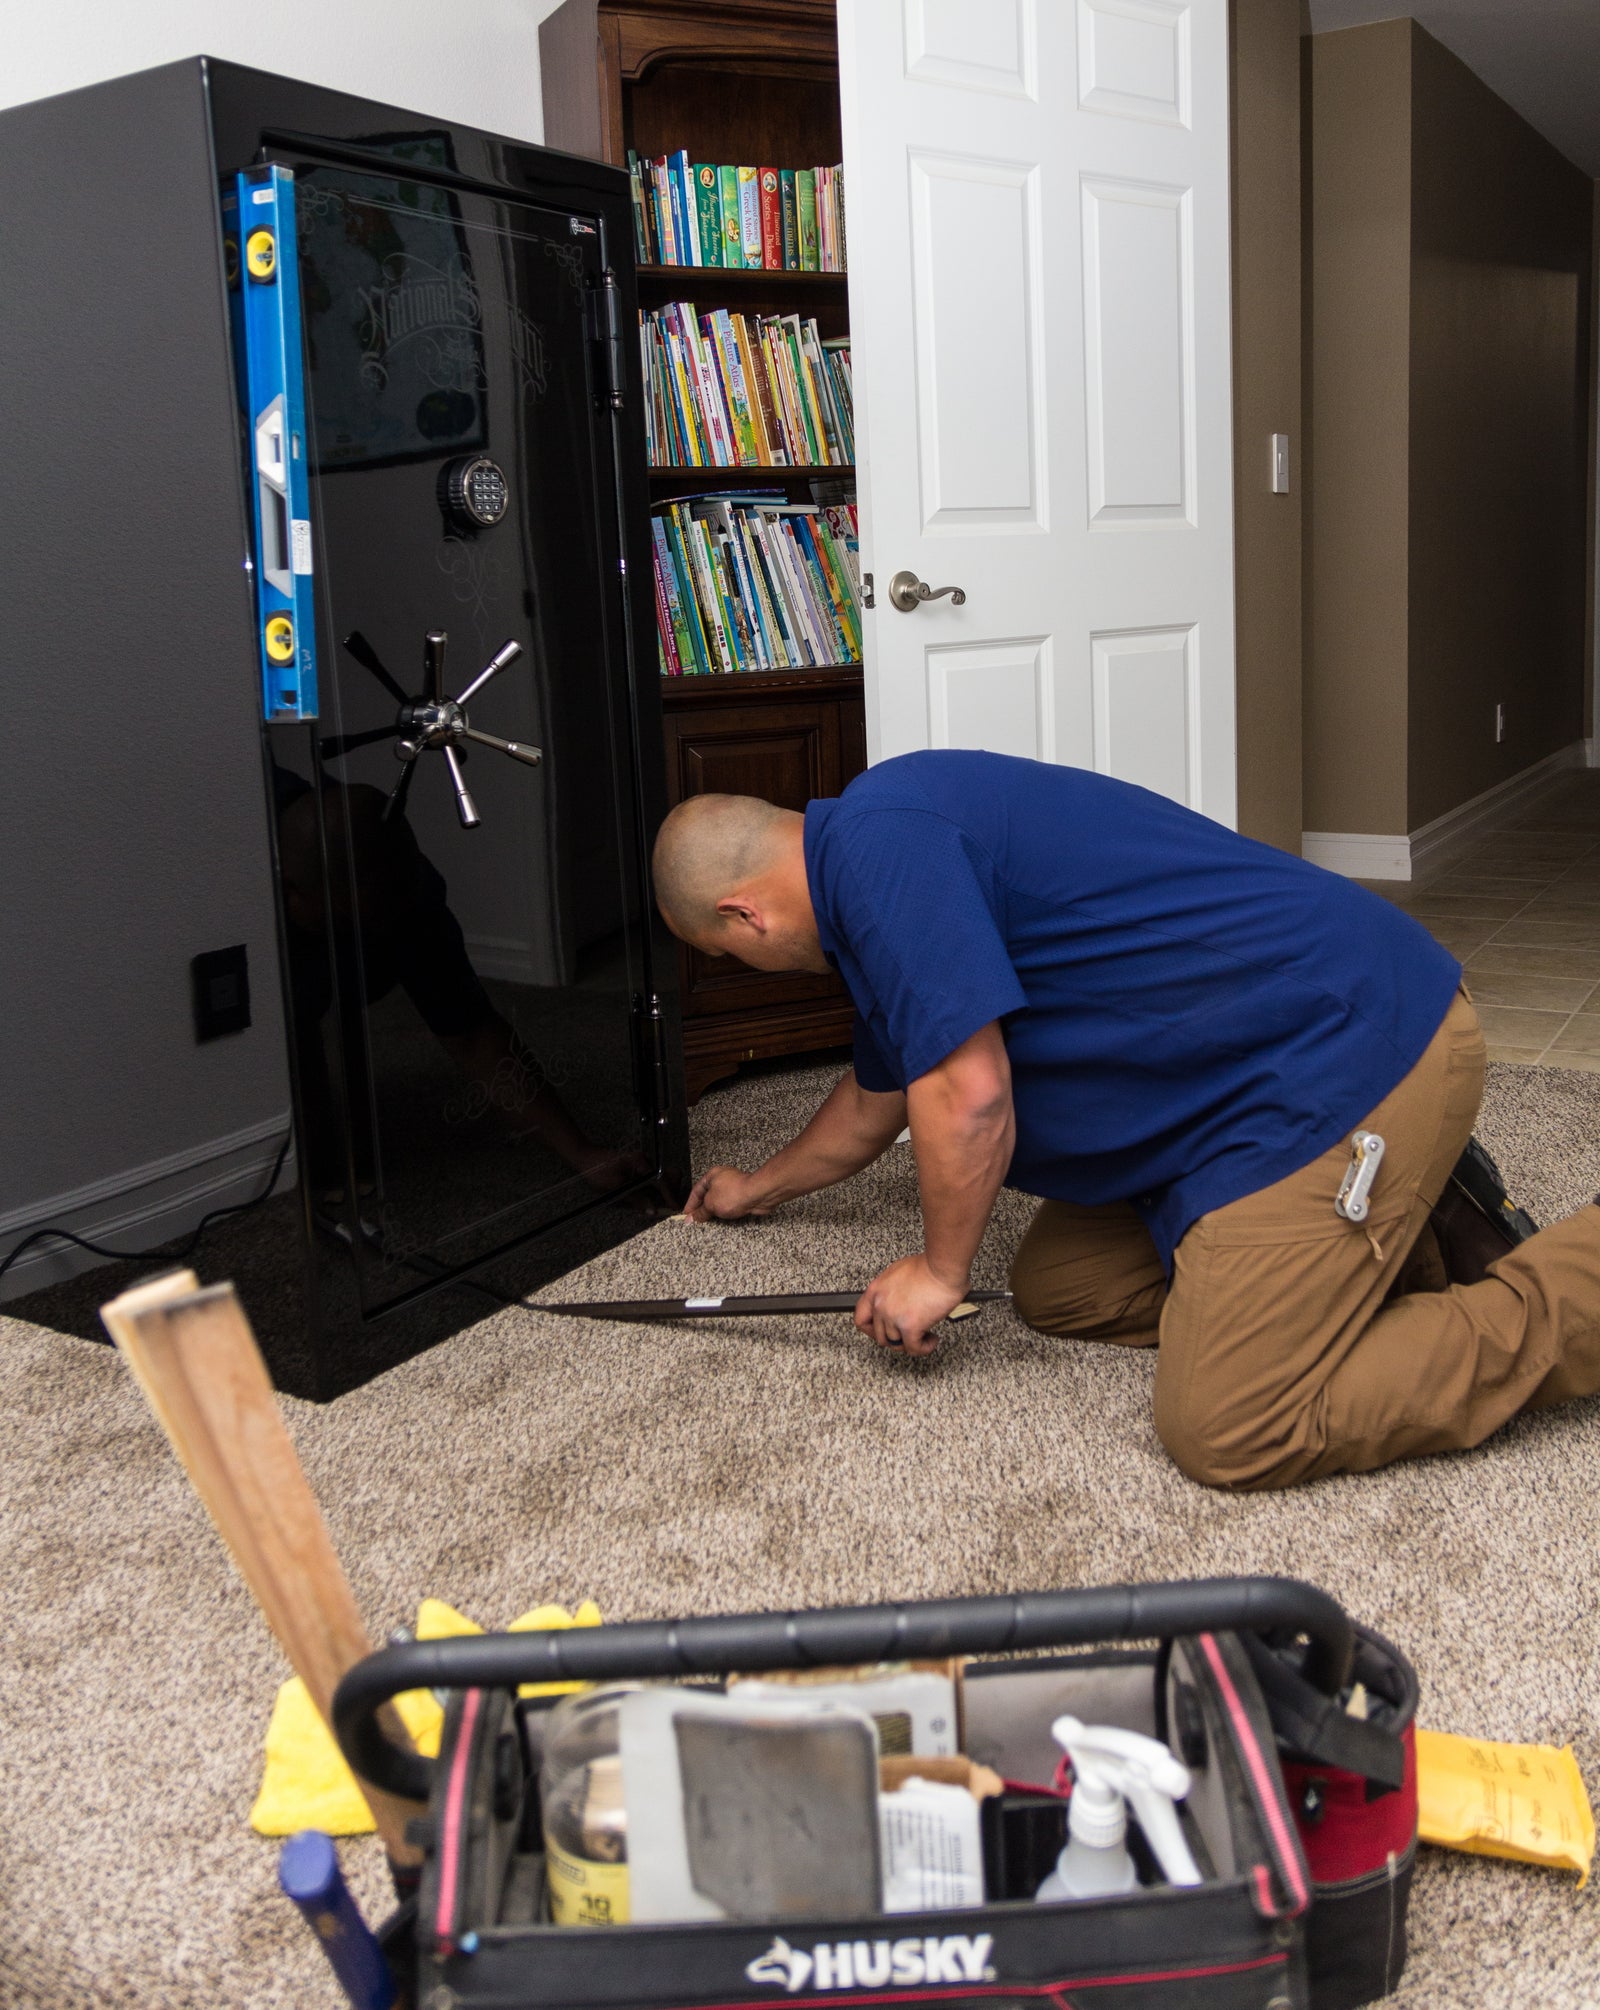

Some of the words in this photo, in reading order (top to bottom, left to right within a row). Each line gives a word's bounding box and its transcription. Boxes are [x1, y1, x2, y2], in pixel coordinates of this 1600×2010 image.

[743, 191, 751, 216] Greek
[764, 195, 773, 221] Stories
[744, 217, 753, 242] Myths
[773, 211, 782, 246] Illustrated
[723, 330, 736, 362] Picture
[730, 363, 741, 388] Atlas
[653, 558, 663, 581] Chinese
[657, 538, 670, 569] Picture
[664, 570, 675, 596] Atlas
[658, 581, 669, 608] Children's
[664, 609, 673, 632] Favorite
[668, 633, 677, 654] Stories
[814, 1933, 993, 1990] HUSKY
